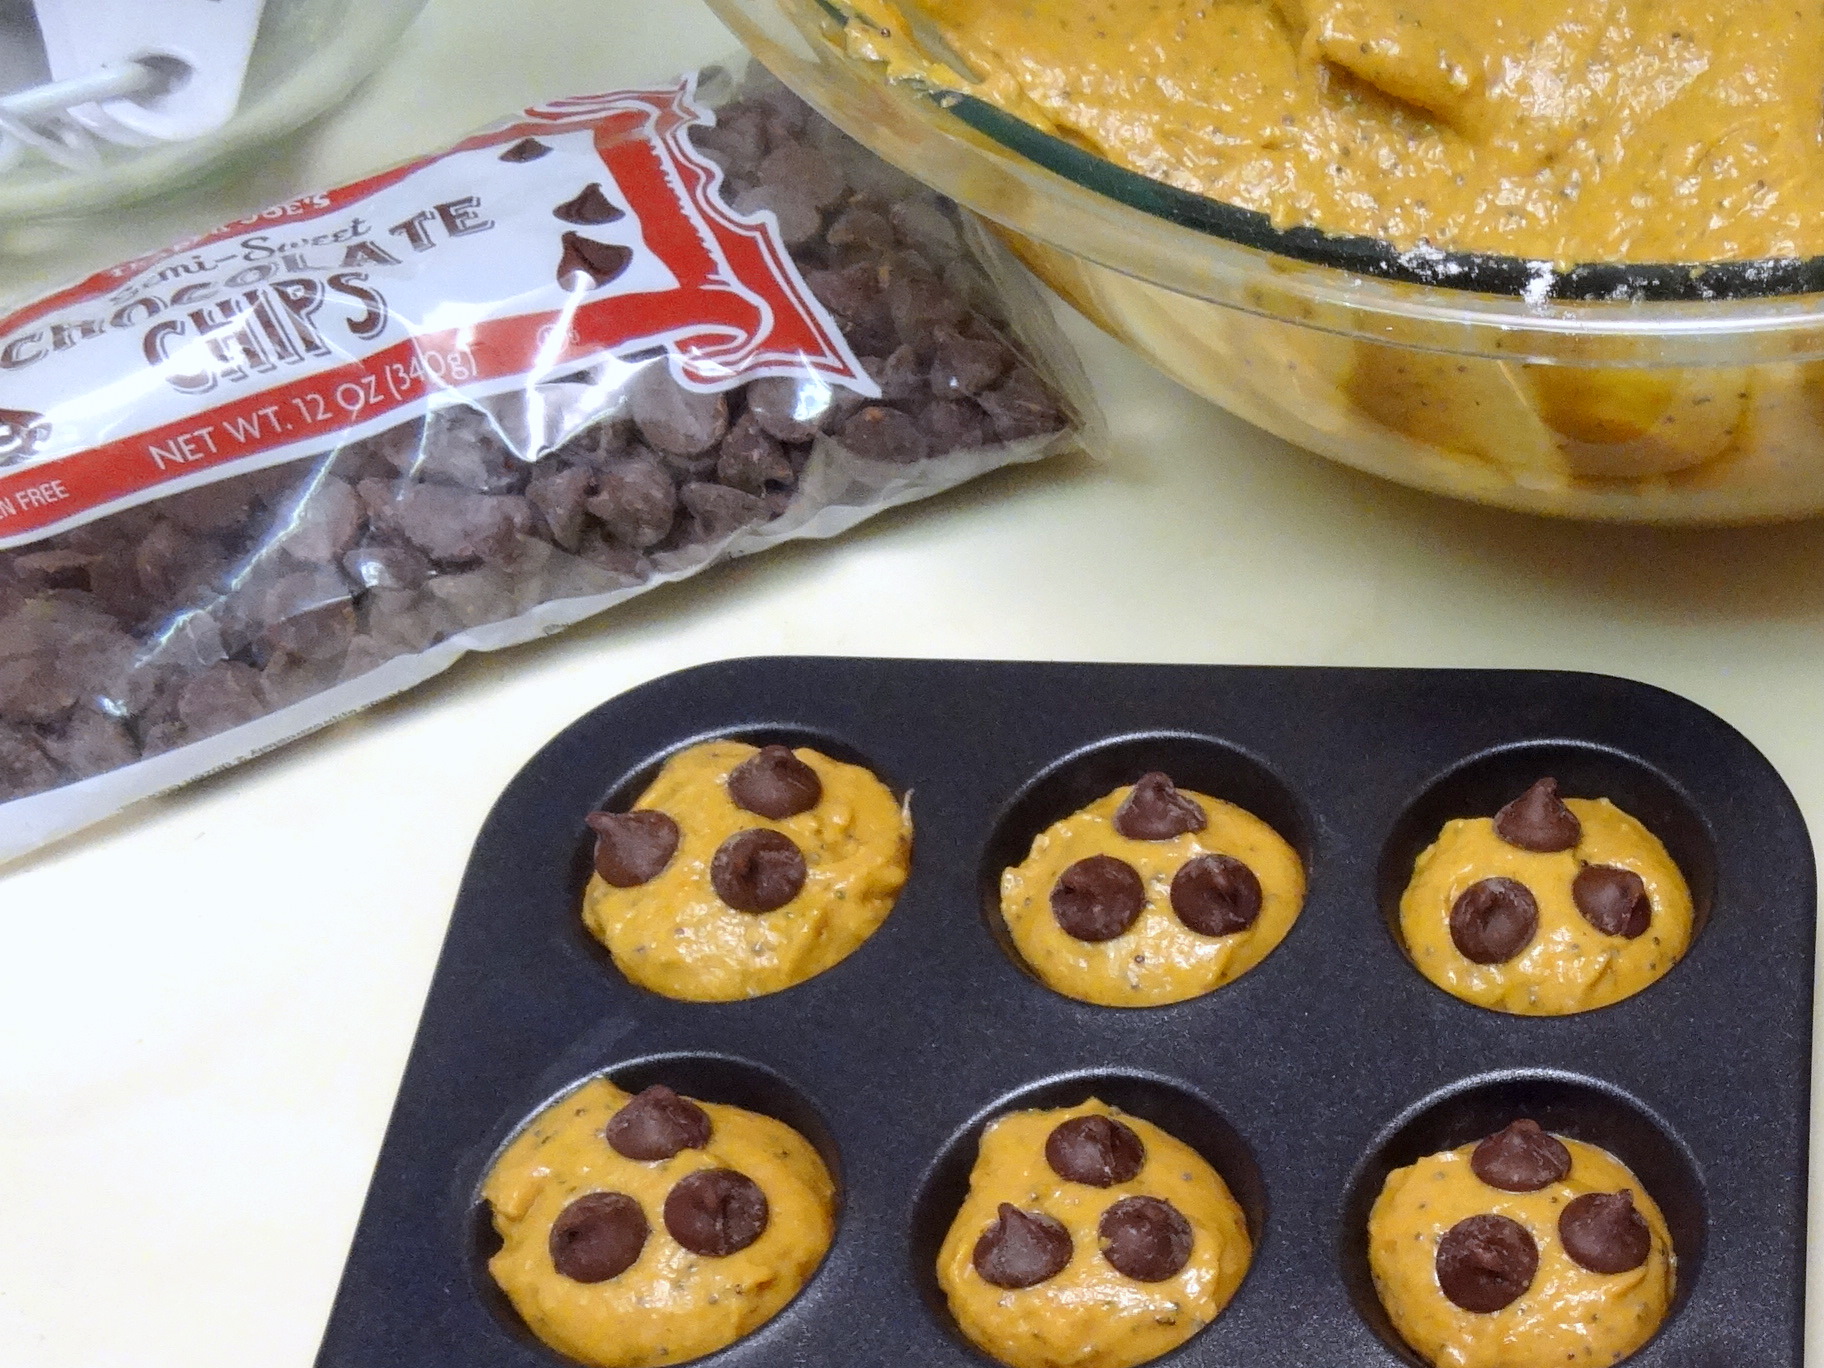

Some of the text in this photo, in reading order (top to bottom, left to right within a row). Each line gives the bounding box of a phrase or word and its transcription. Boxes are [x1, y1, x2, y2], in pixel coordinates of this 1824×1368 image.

[0, 195, 495, 370] CHOCOLATE
[109, 217, 372, 305] Semi-Sweet
[142, 271, 389, 395] CHIPS
[148, 344, 479, 470] NET WT. 12 OZ (340g)
[15, 479, 70, 512] FREE
